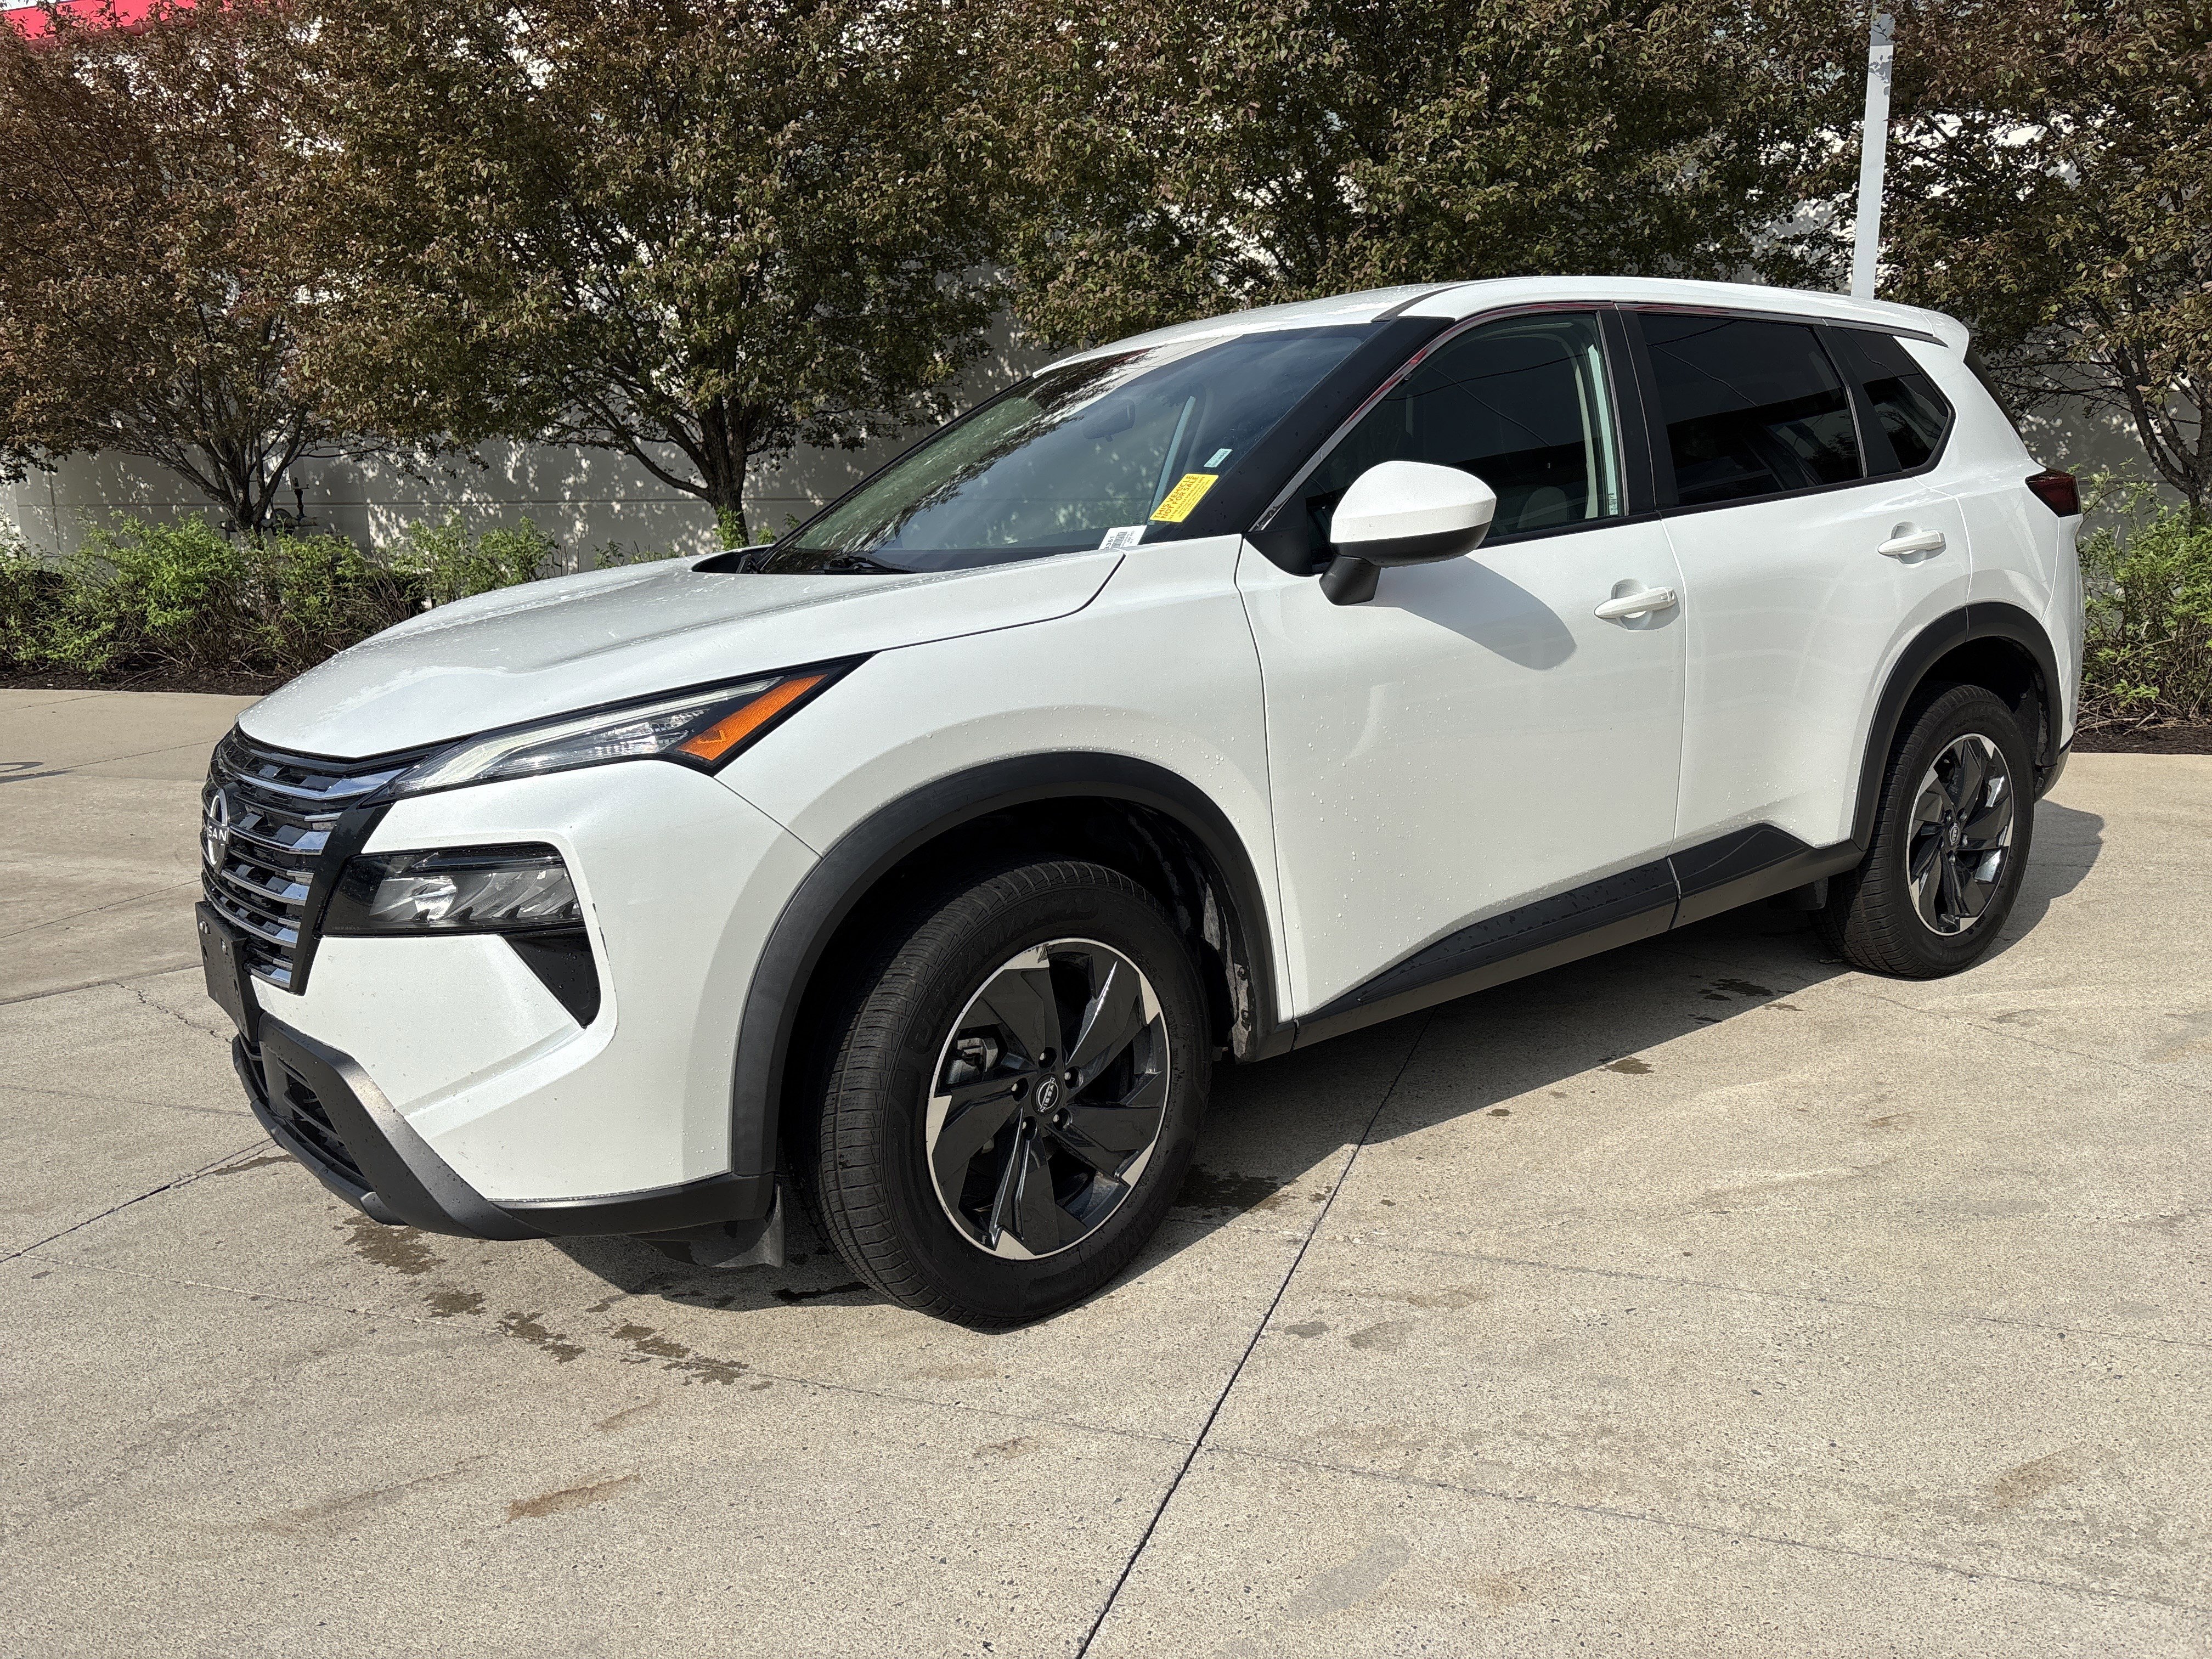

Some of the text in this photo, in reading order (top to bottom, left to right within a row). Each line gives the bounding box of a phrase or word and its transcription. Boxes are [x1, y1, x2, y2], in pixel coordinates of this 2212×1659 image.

[1153, 504, 1170, 518] THIS
[1166, 476, 1193, 503] VEHICLE
[1160, 505, 1174, 518] NOT
[1172, 492, 1186, 504] FOR
[1183, 476, 1199, 491] SALE
[1040, 1076, 1056, 1113] NISSAN
